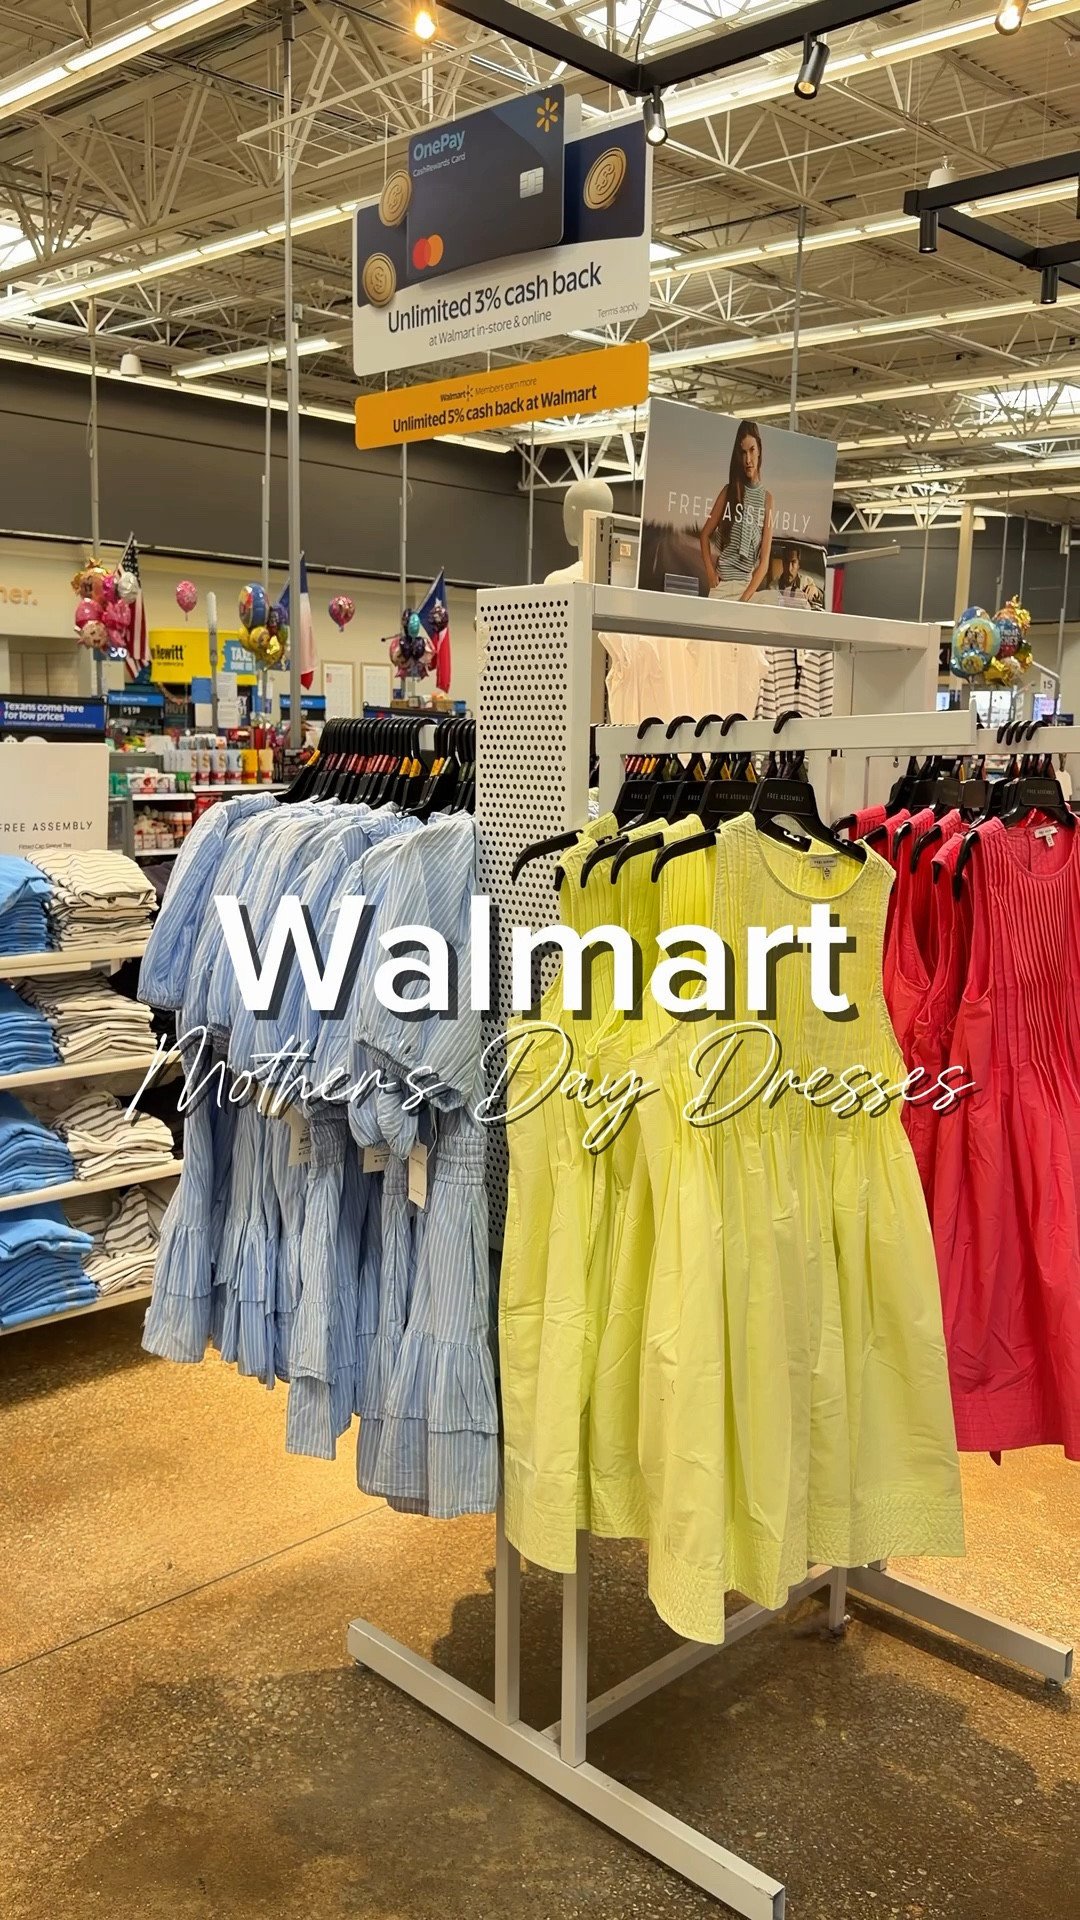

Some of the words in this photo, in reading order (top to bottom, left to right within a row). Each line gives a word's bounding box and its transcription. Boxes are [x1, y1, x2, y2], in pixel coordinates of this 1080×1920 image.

[413, 130, 465, 161] OnePay
[413, 159, 450, 177] CashRewards
[451, 152, 466, 164] Card
[388, 292, 472, 334] Unlimited
[474, 285, 502, 315] 3%
[504, 275, 548, 306] cash
[553, 261, 602, 296] back
[597, 307, 618, 318] Terms
[428, 335, 438, 347] at
[438, 326, 475, 345] Walmart
[476, 318, 512, 336] in-store
[513, 315, 521, 328] &
[521, 310, 552, 327] online
[440, 391, 466, 402] Walmart
[475, 384, 504, 395] Members
[519, 378, 537, 387] more
[393, 411, 447, 433] Unlimited
[447, 408, 465, 424] 5%
[466, 403, 493, 420] cash
[495, 397, 524, 416] back
[526, 394, 539, 410] at
[540, 385, 597, 408] Walmart
[667, 491, 712, 519] FREE
[722, 502, 811, 534] ASSEMBLY
[4, 702, 36, 712] Texans
[37, 704, 62, 713] come
[63, 704, 84, 713] here
[4, 711, 18, 720] for
[19, 711, 36, 721] low
[36, 712, 65, 722] prices
[780, 793, 804, 802] ASSEMBLY
[33, 821, 92, 832] ASSEMBLY
